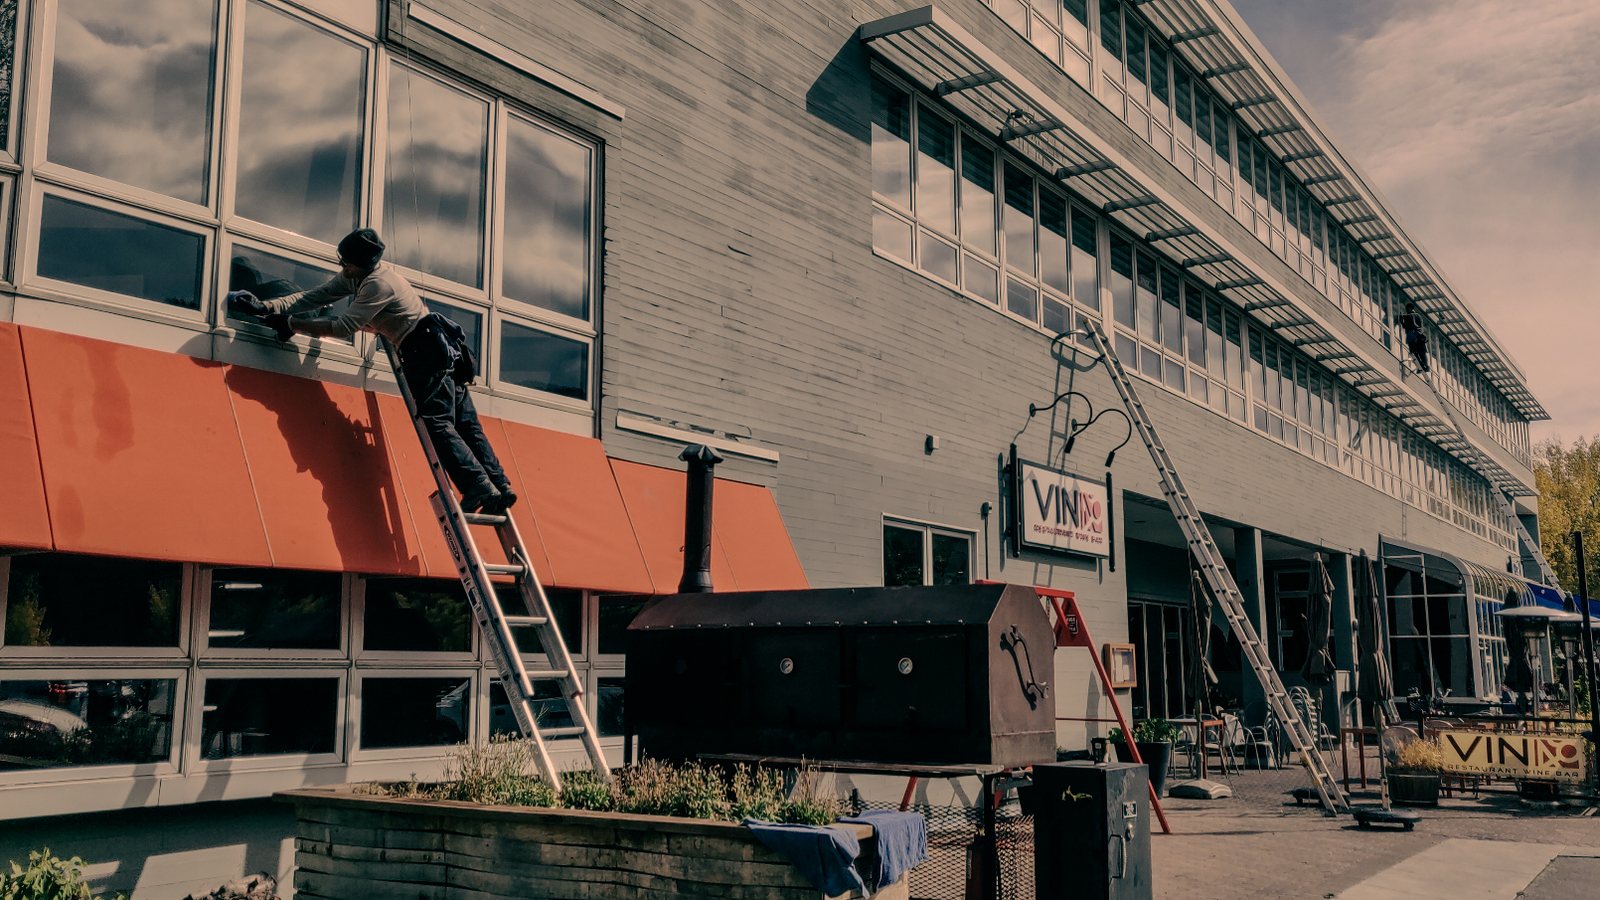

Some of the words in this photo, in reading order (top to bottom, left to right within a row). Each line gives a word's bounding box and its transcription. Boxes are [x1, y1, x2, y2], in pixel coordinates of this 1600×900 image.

[1447, 764, 1517, 775] RESTAURANT
[1523, 768, 1550, 776] WINE
[1555, 770, 1579, 778] BAR
